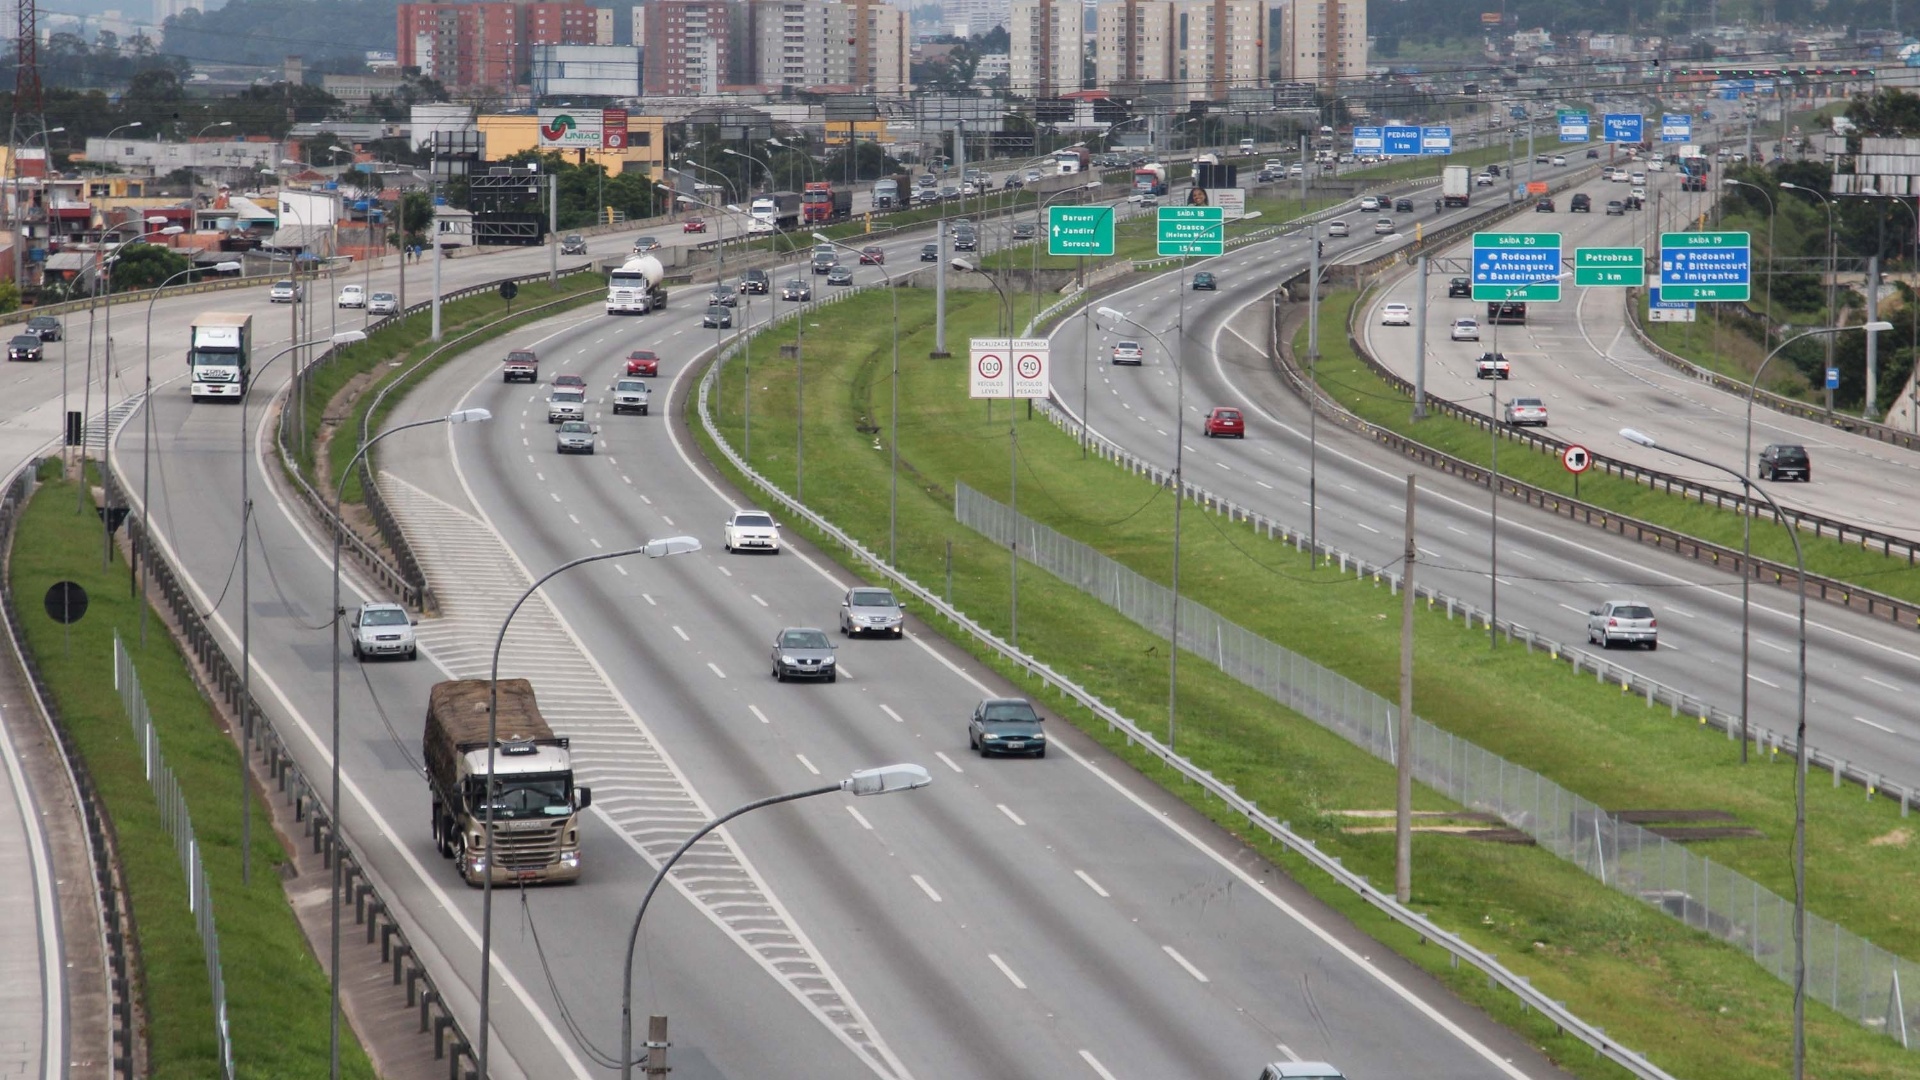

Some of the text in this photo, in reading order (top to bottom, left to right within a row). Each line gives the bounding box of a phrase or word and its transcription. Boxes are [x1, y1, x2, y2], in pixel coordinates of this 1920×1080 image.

[1608, 118, 1638, 126] PEDÁGIO
[1388, 129, 1418, 138] PEDÁGIO
[1500, 236, 1520, 244] SAÍDA
[1689, 236, 1710, 244] SAÍDA
[1494, 263, 1554, 272] Anhanguera
[1685, 272, 1740, 282] Imigrantes
[982, 362, 999, 371] 100
[1023, 362, 1036, 370] 90
